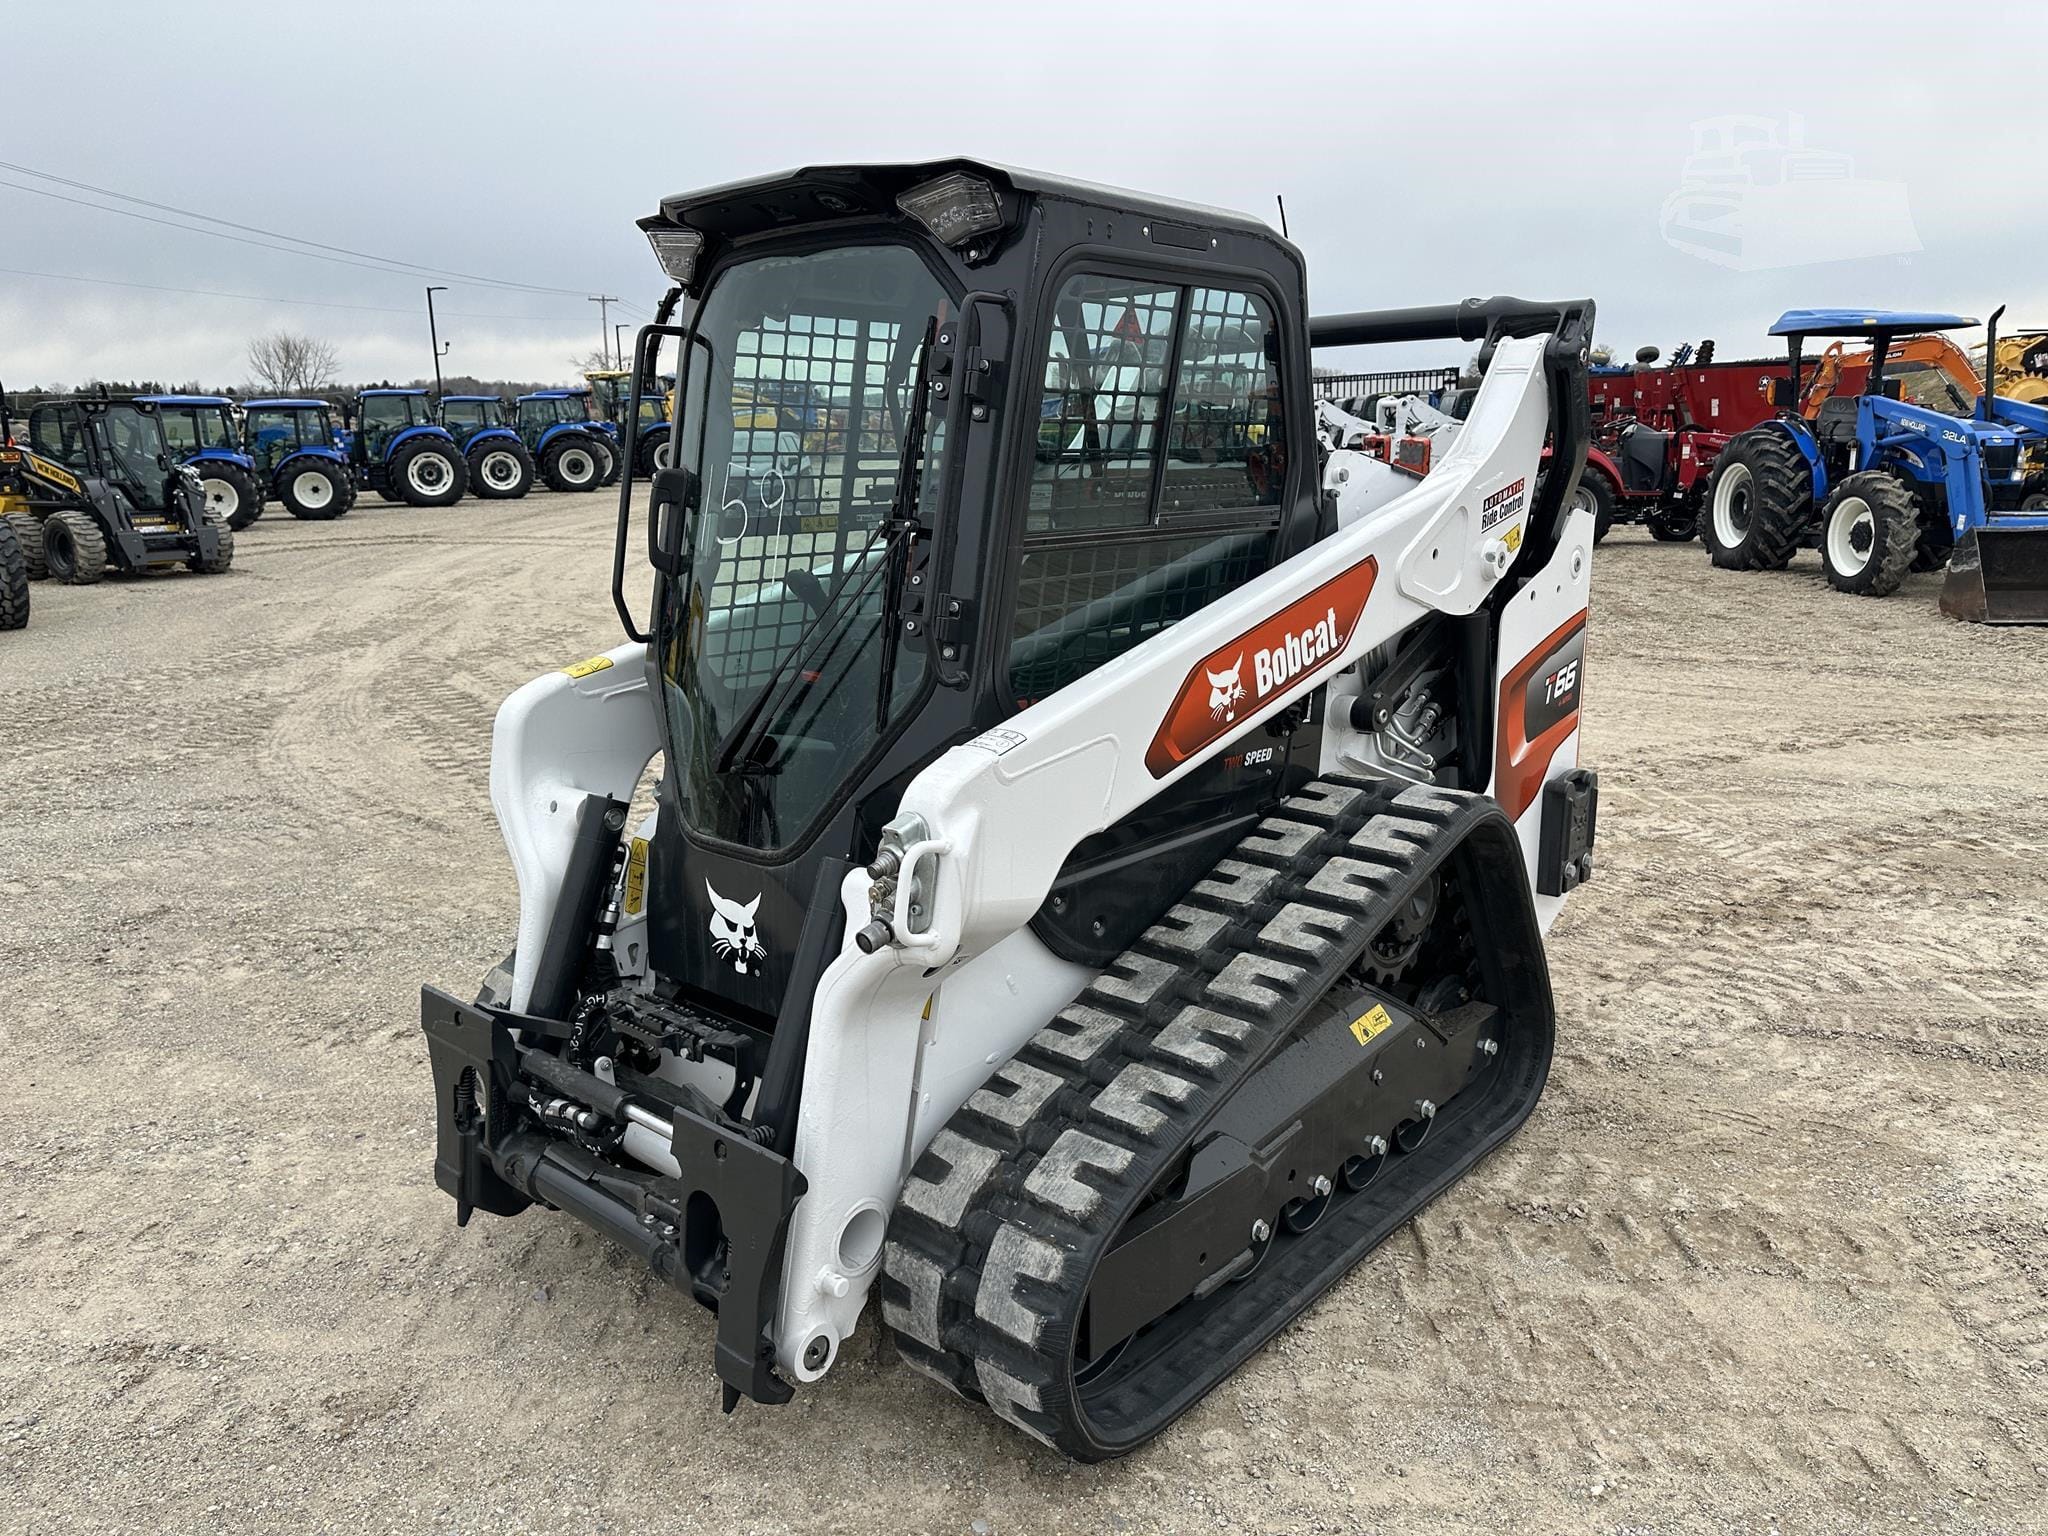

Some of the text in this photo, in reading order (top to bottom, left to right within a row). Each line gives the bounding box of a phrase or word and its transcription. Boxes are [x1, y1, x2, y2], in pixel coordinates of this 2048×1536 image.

[1942, 430, 1966, 445] 32LA
[49, 468, 75, 487] HOLLAND
[1482, 492, 1524, 530] Ride Control
[1484, 480, 1524, 511] AUTOMATIC
[700, 462, 785, 585] 159
[1254, 607, 1338, 698] Bobcat
[1545, 659, 1578, 705] T66
[1224, 747, 1273, 768] TWO SPEED
